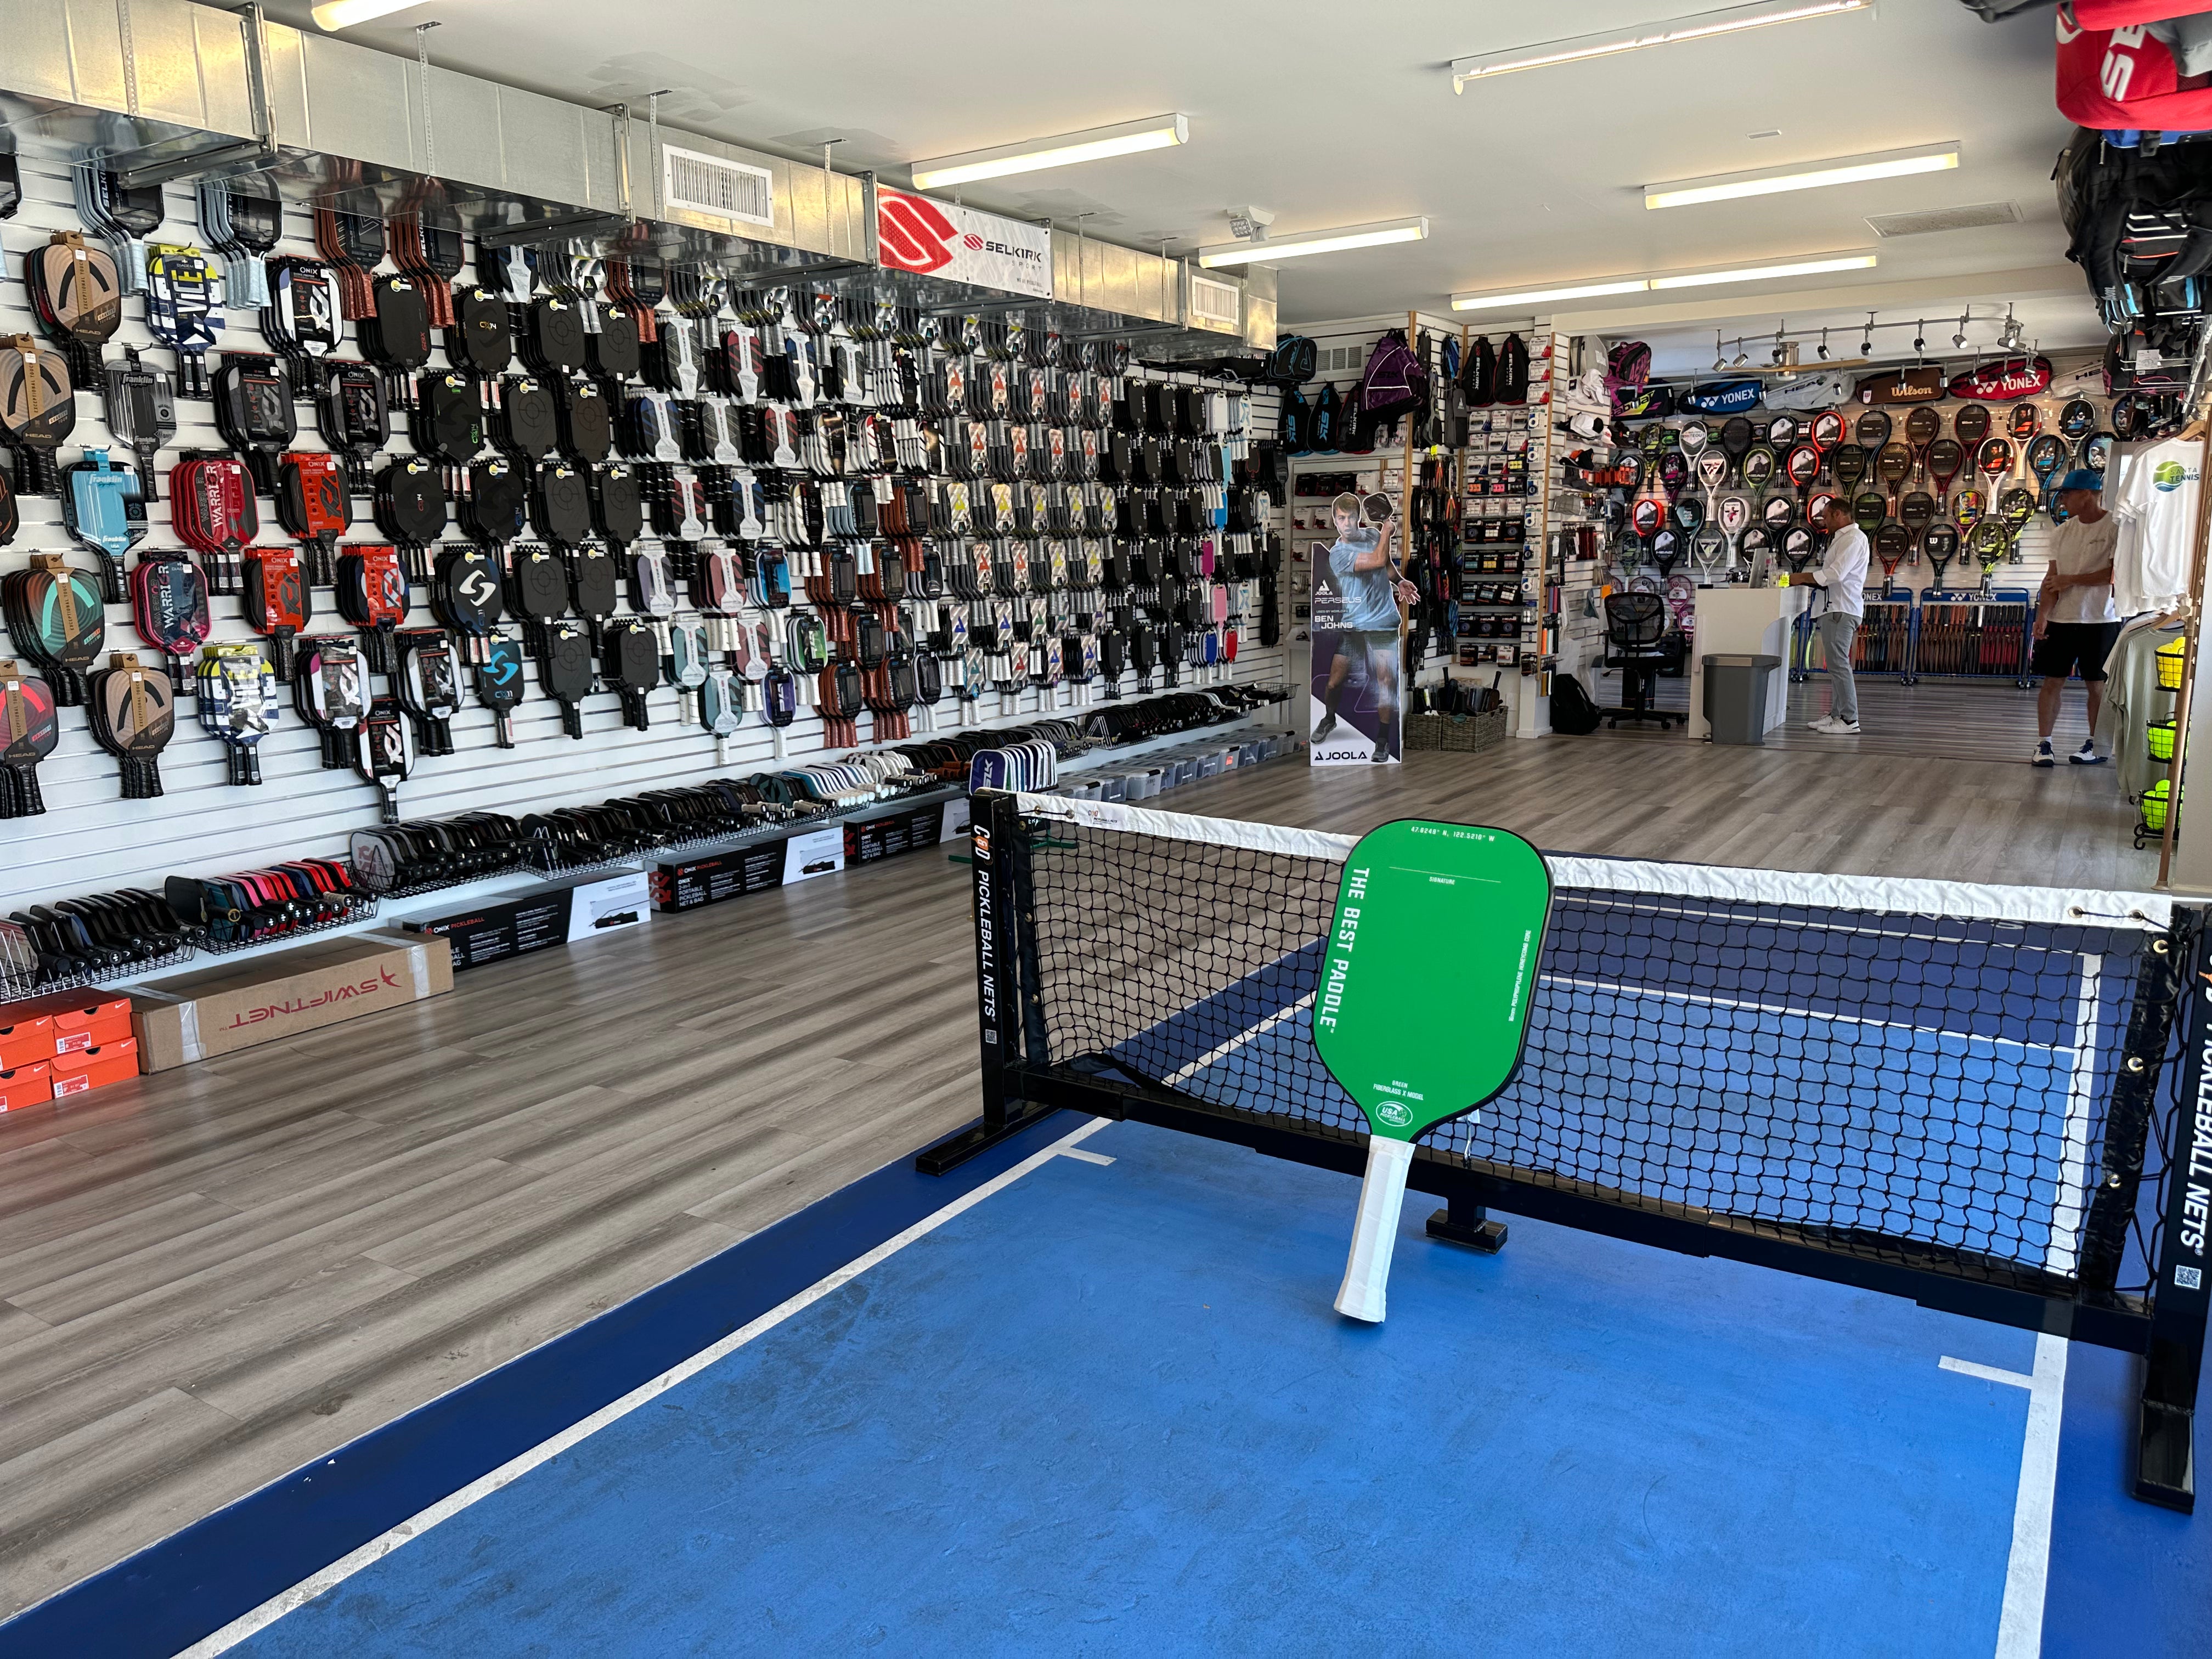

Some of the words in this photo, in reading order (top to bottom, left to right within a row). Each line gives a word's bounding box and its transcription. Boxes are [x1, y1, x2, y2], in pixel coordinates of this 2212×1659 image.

[985, 241, 1042, 263] SELKIRK
[300, 266, 318, 275] ONIX
[1012, 260, 1042, 271] SPORT
[348, 370, 365, 379] ONIX
[2000, 374, 2041, 392] YONEX
[1722, 388, 1755, 404] YONEX
[2169, 474, 2200, 482] TENNIS
[1861, 593, 1882, 601] ONEX
[1325, 751, 1368, 760] JOOLA
[1347, 867, 1370, 900] THE
[1429, 876, 1455, 885] SIGNATURE
[679, 885, 703, 896] PORTABLE
[679, 890, 708, 901] PICKLEBALL
[433, 924, 450, 933] ONIX
[451, 917, 485, 929] PICKLEBALL
[978, 870, 994, 970] PICKLEBALL
[1336, 906, 1361, 952] BEST
[1392, 1080, 1408, 1088] GREEN
[1373, 1083, 1402, 1095] FIBERGLASS
[1407, 1091, 1424, 1101] MODEL
[1380, 1112, 1406, 1122] PICKLEBALL
[1381, 1107, 1398, 1116] USA
